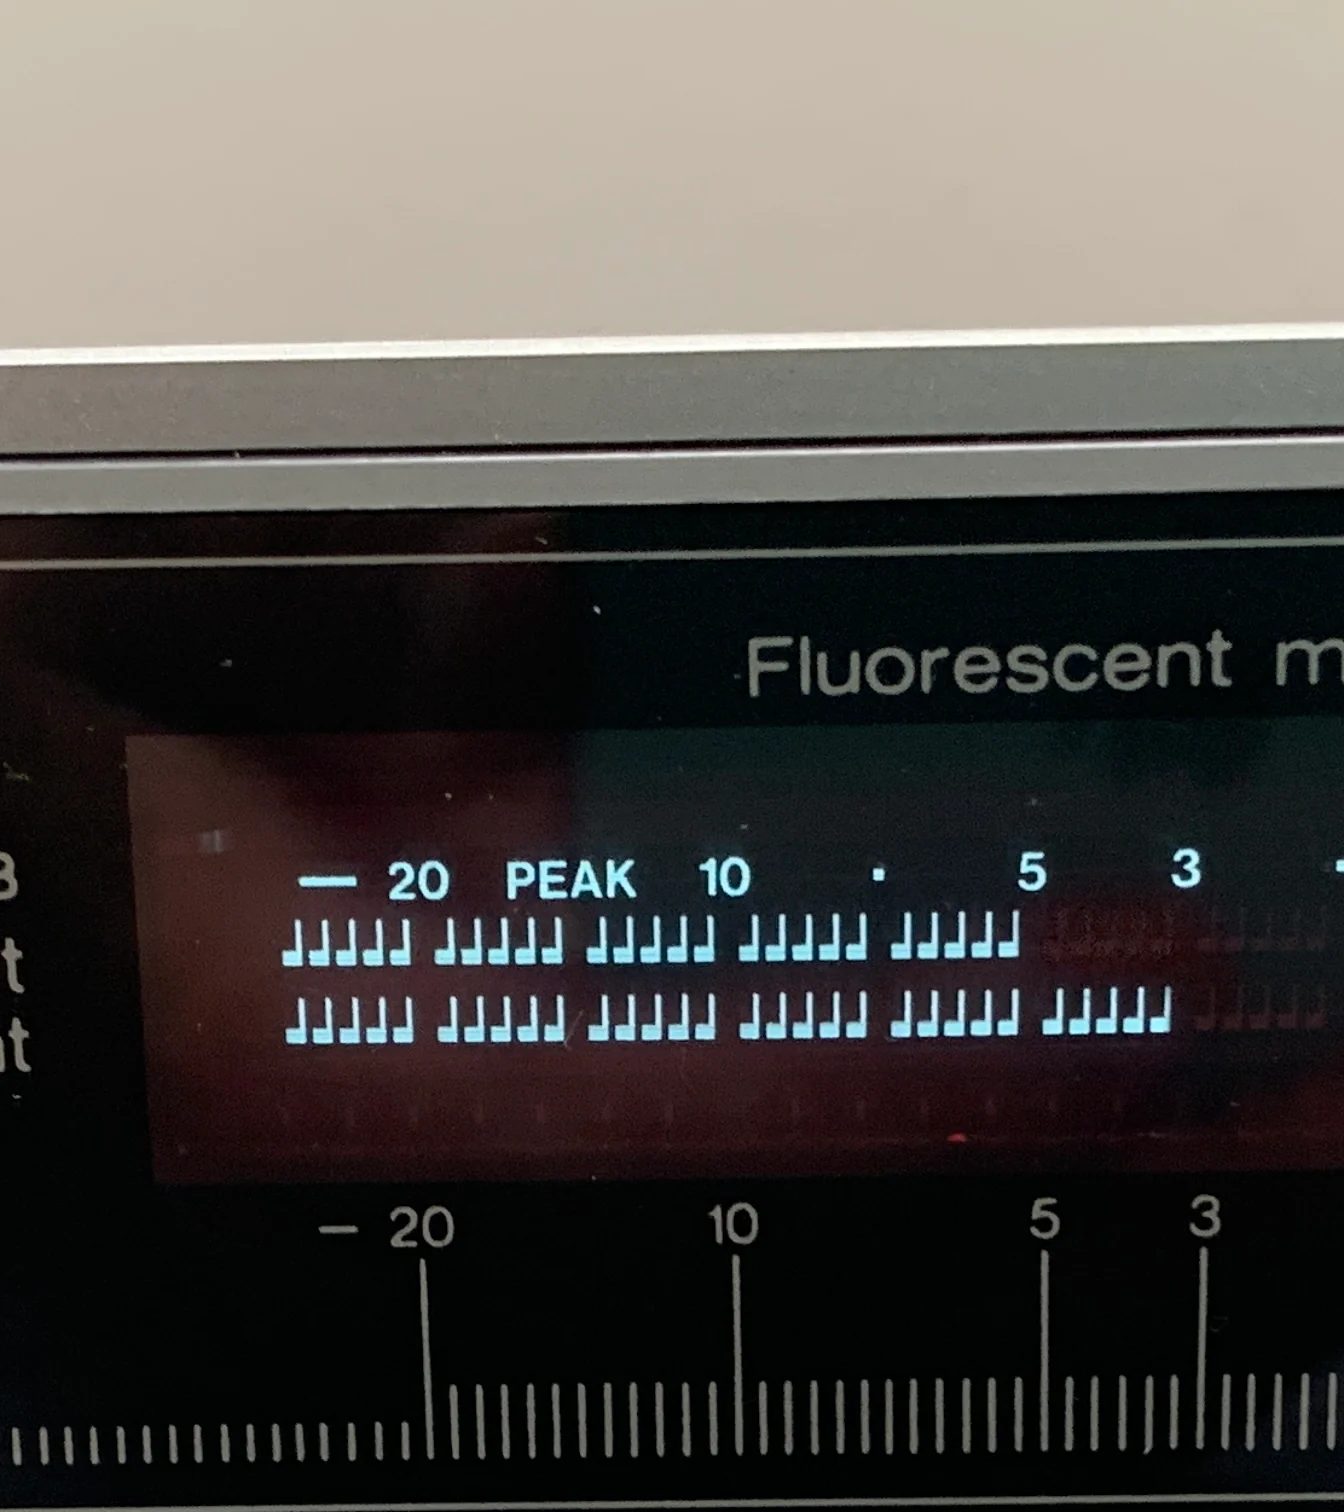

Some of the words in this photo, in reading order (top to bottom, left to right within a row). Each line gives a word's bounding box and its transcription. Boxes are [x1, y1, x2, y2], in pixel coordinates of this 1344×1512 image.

[747, 628, 1234, 699] Fluorescent
[387, 859, 451, 902] 20
[505, 858, 638, 901] PEAK
[698, 855, 752, 898] 10
[1016, 850, 1048, 893] 5
[1170, 846, 1203, 890] 3
[388, 1204, 456, 1249] 20
[707, 1201, 760, 1246] 10
[1028, 1196, 1062, 1241] 5
[1188, 1193, 1222, 1239] 3
